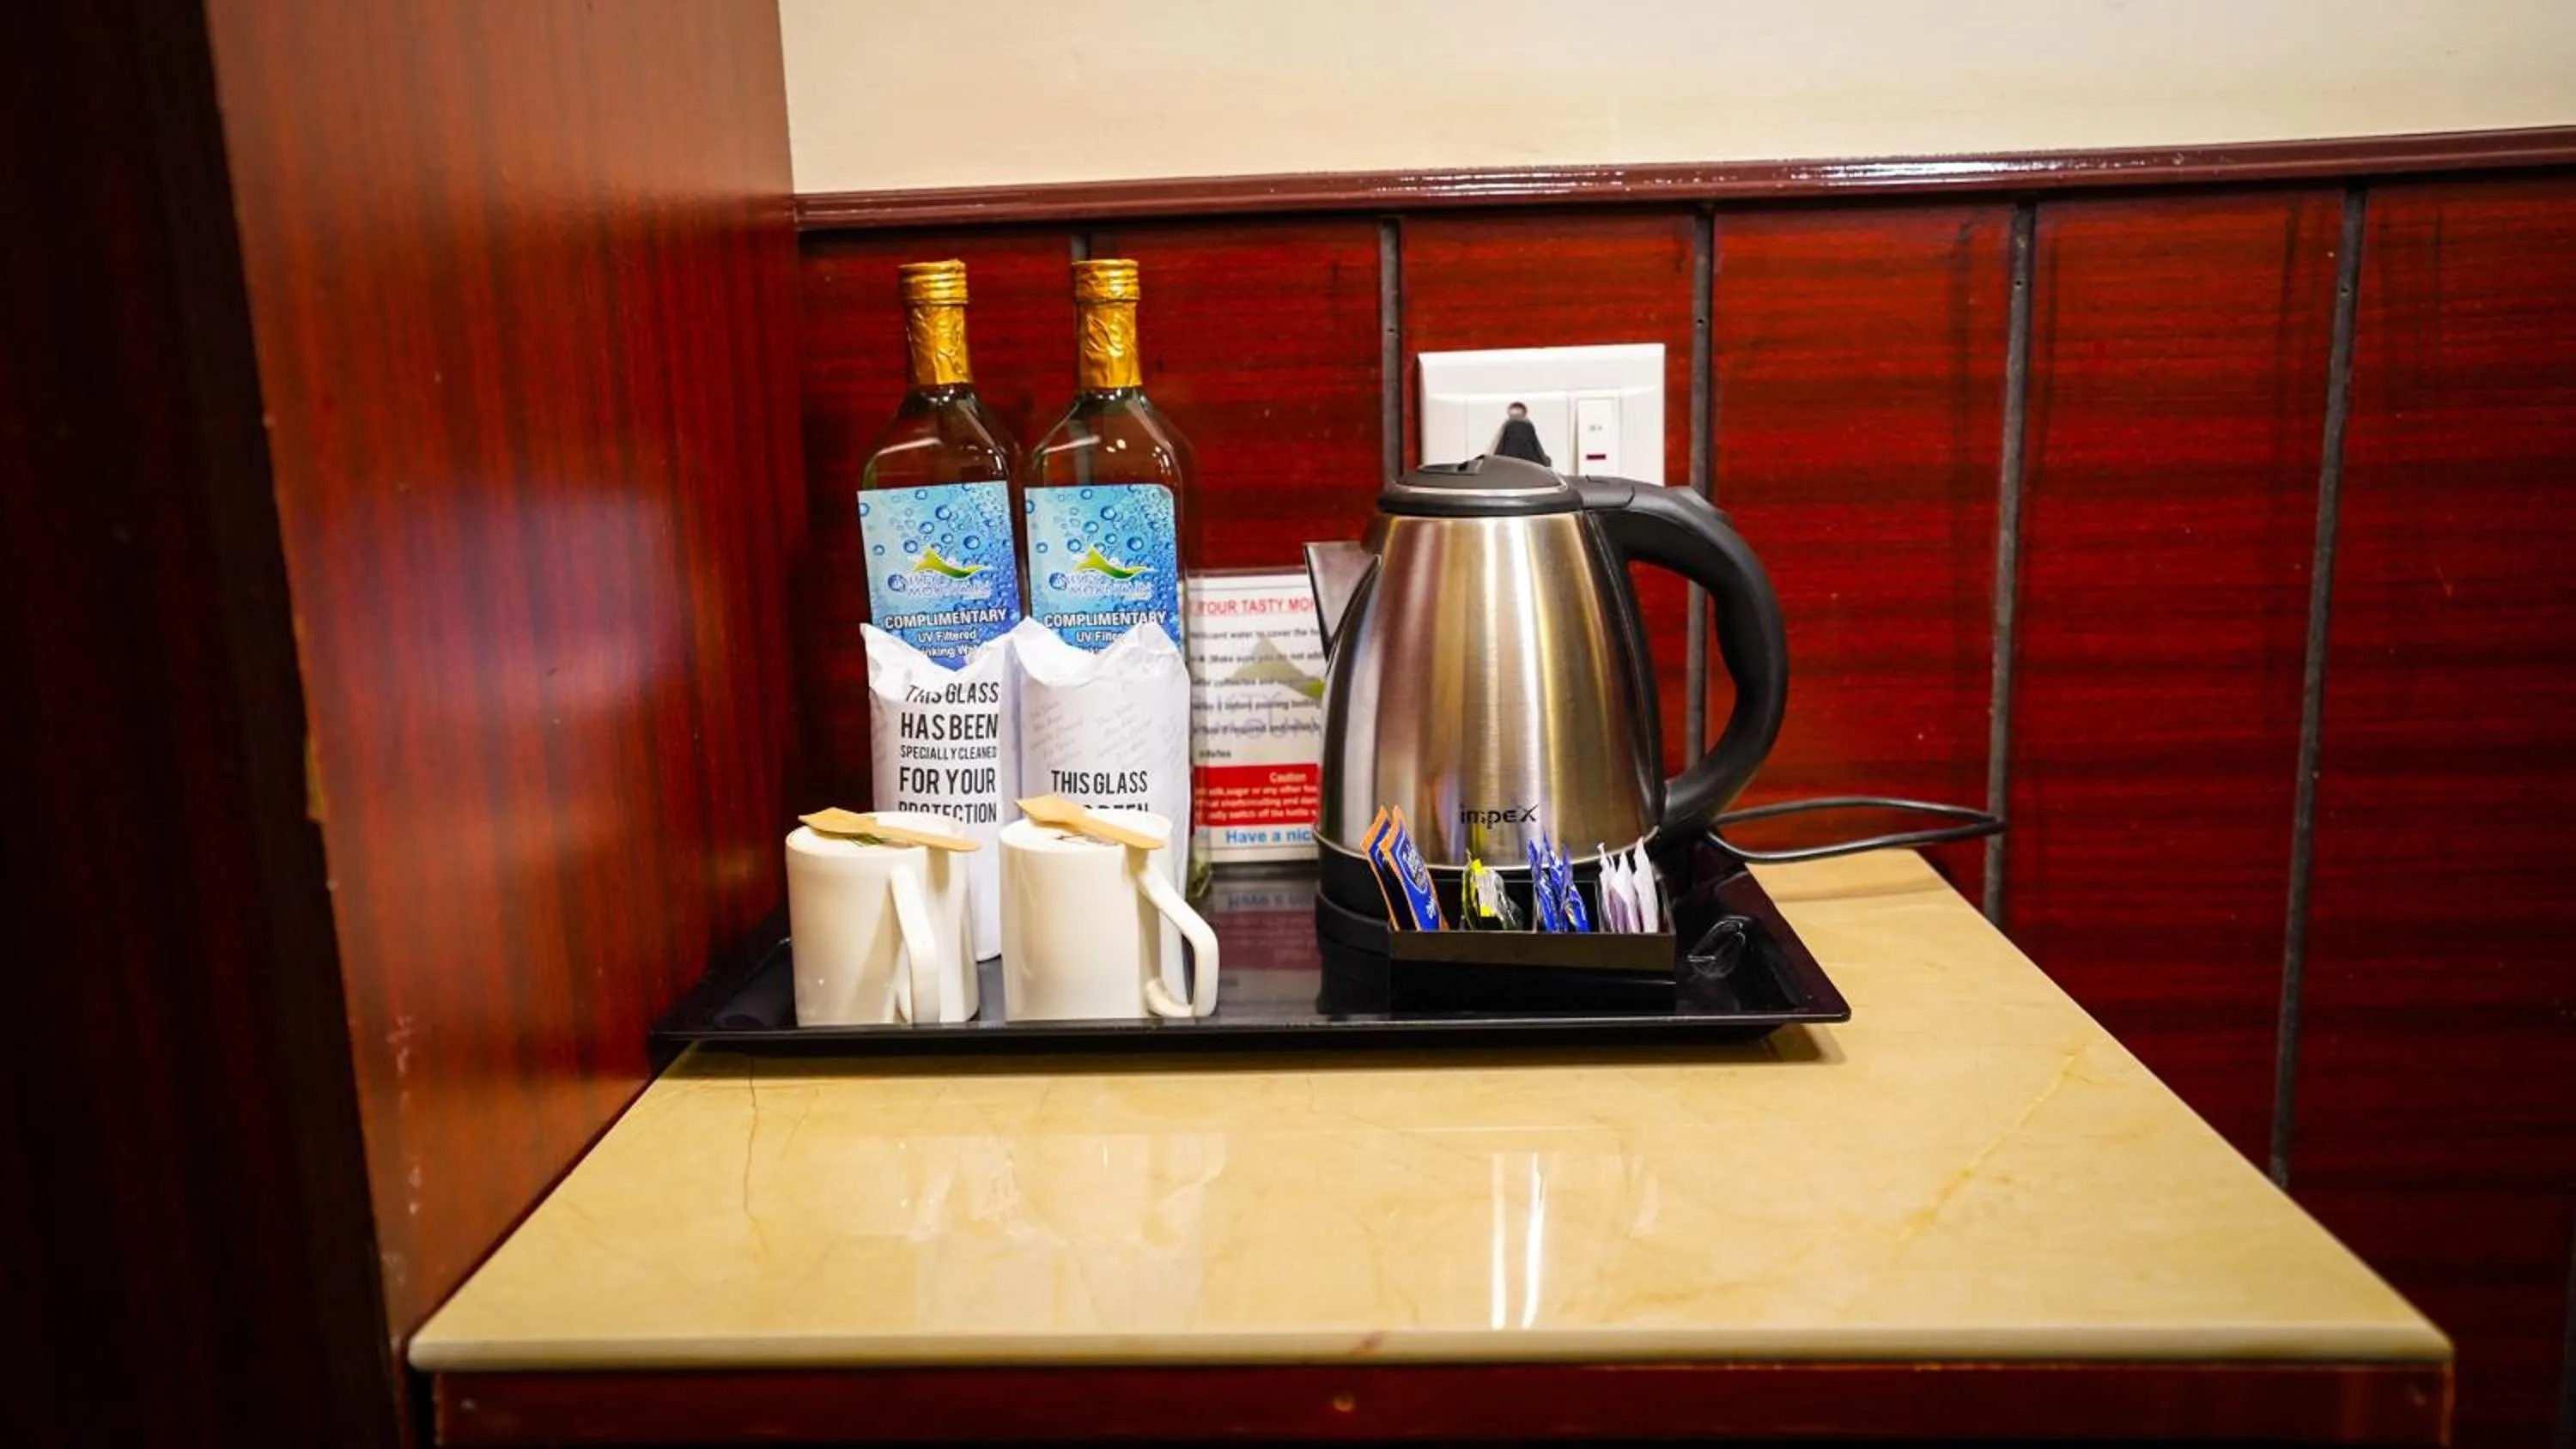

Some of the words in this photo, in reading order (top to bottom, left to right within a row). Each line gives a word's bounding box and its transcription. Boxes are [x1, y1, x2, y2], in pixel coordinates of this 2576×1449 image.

[1241, 599, 1284, 613] TASTY
[884, 609, 1007, 629] COMPLIMENTARY
[1043, 610, 1167, 627] COMPLIMENTARY
[918, 633, 933, 643] UV
[937, 629, 976, 642] Filtered
[1076, 631, 1091, 642] UV
[945, 682, 999, 704] GLASS
[901, 712, 945, 740] HAS
[949, 712, 999, 740] BEEN
[901, 744, 957, 761] SPECIALLY
[957, 745, 997, 761] CLEANED
[899, 766, 939, 794] FOR
[945, 767, 996, 795] YOUR
[1050, 769, 1090, 795] THIS
[1093, 770, 1148, 795] GLASS
[1269, 772, 1307, 784] Caution
[1225, 829, 1267, 845] Have
[1272, 833, 1283, 842] a
[1287, 828, 1311, 842] nic
